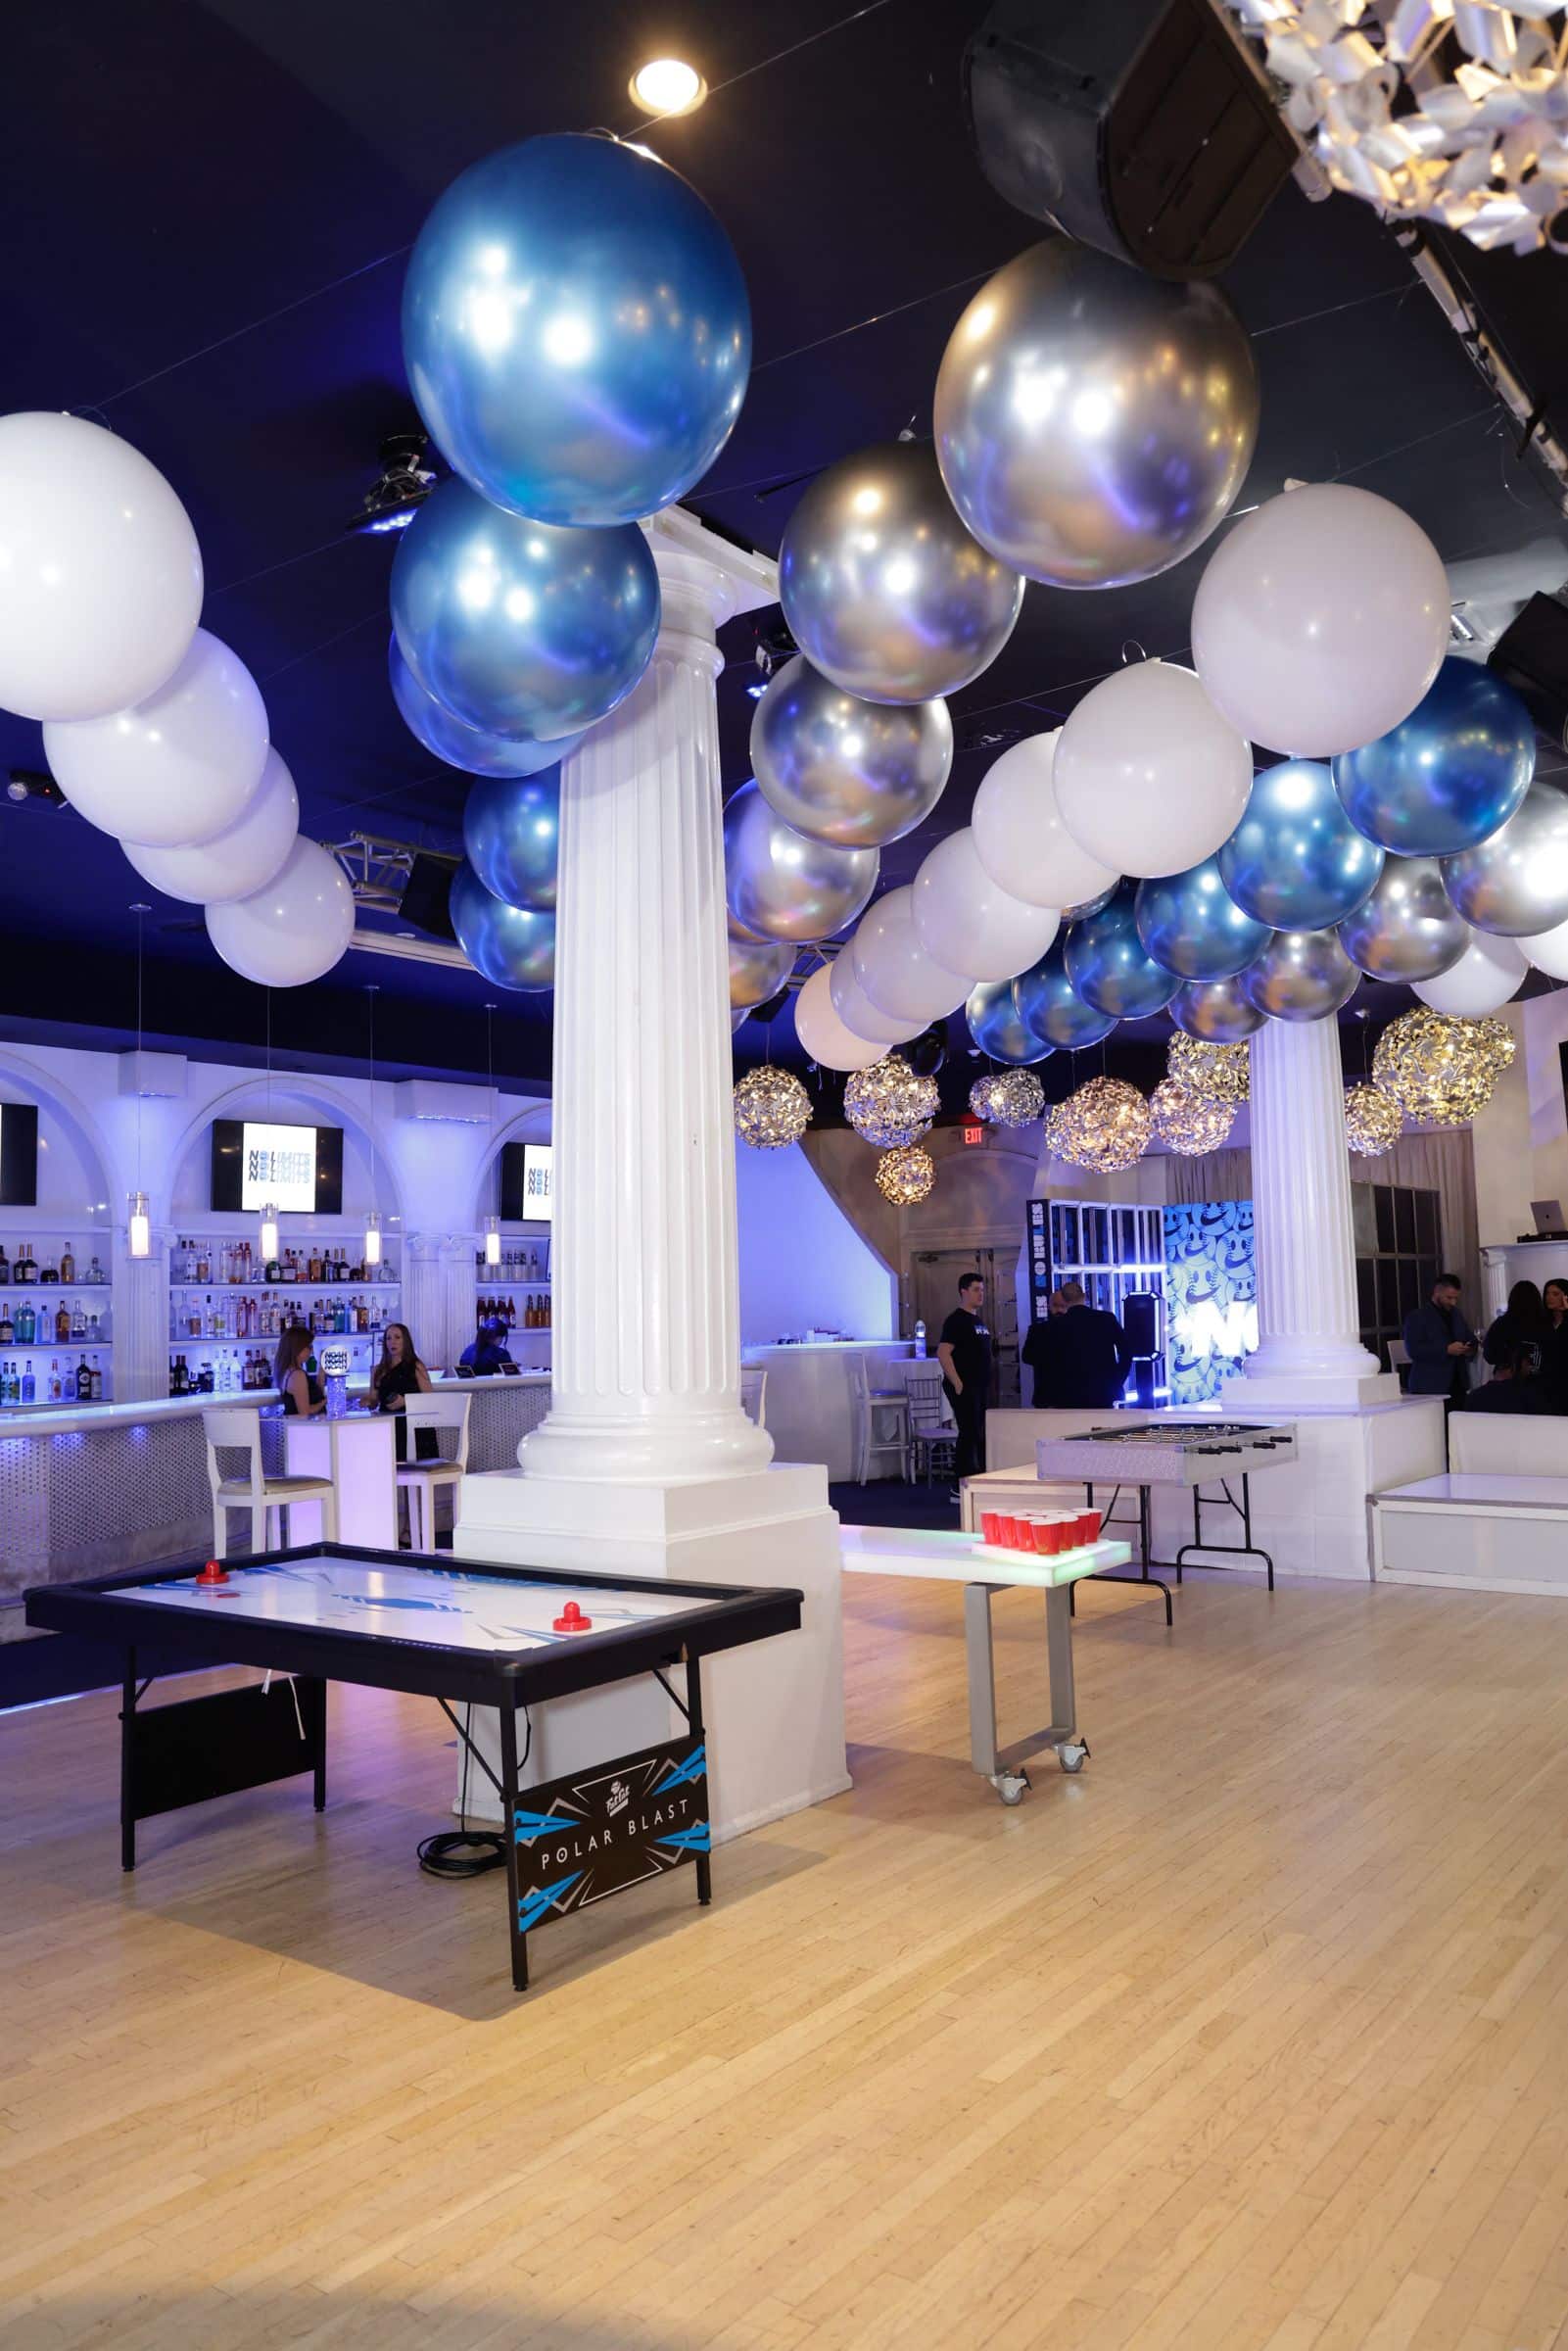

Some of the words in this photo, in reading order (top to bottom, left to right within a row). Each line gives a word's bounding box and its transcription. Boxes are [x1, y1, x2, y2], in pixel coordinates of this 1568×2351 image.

[965, 1128, 982, 1144] EXIT
[542, 1829, 612, 1870] POLAR
[628, 1799, 688, 1836] BLAST
